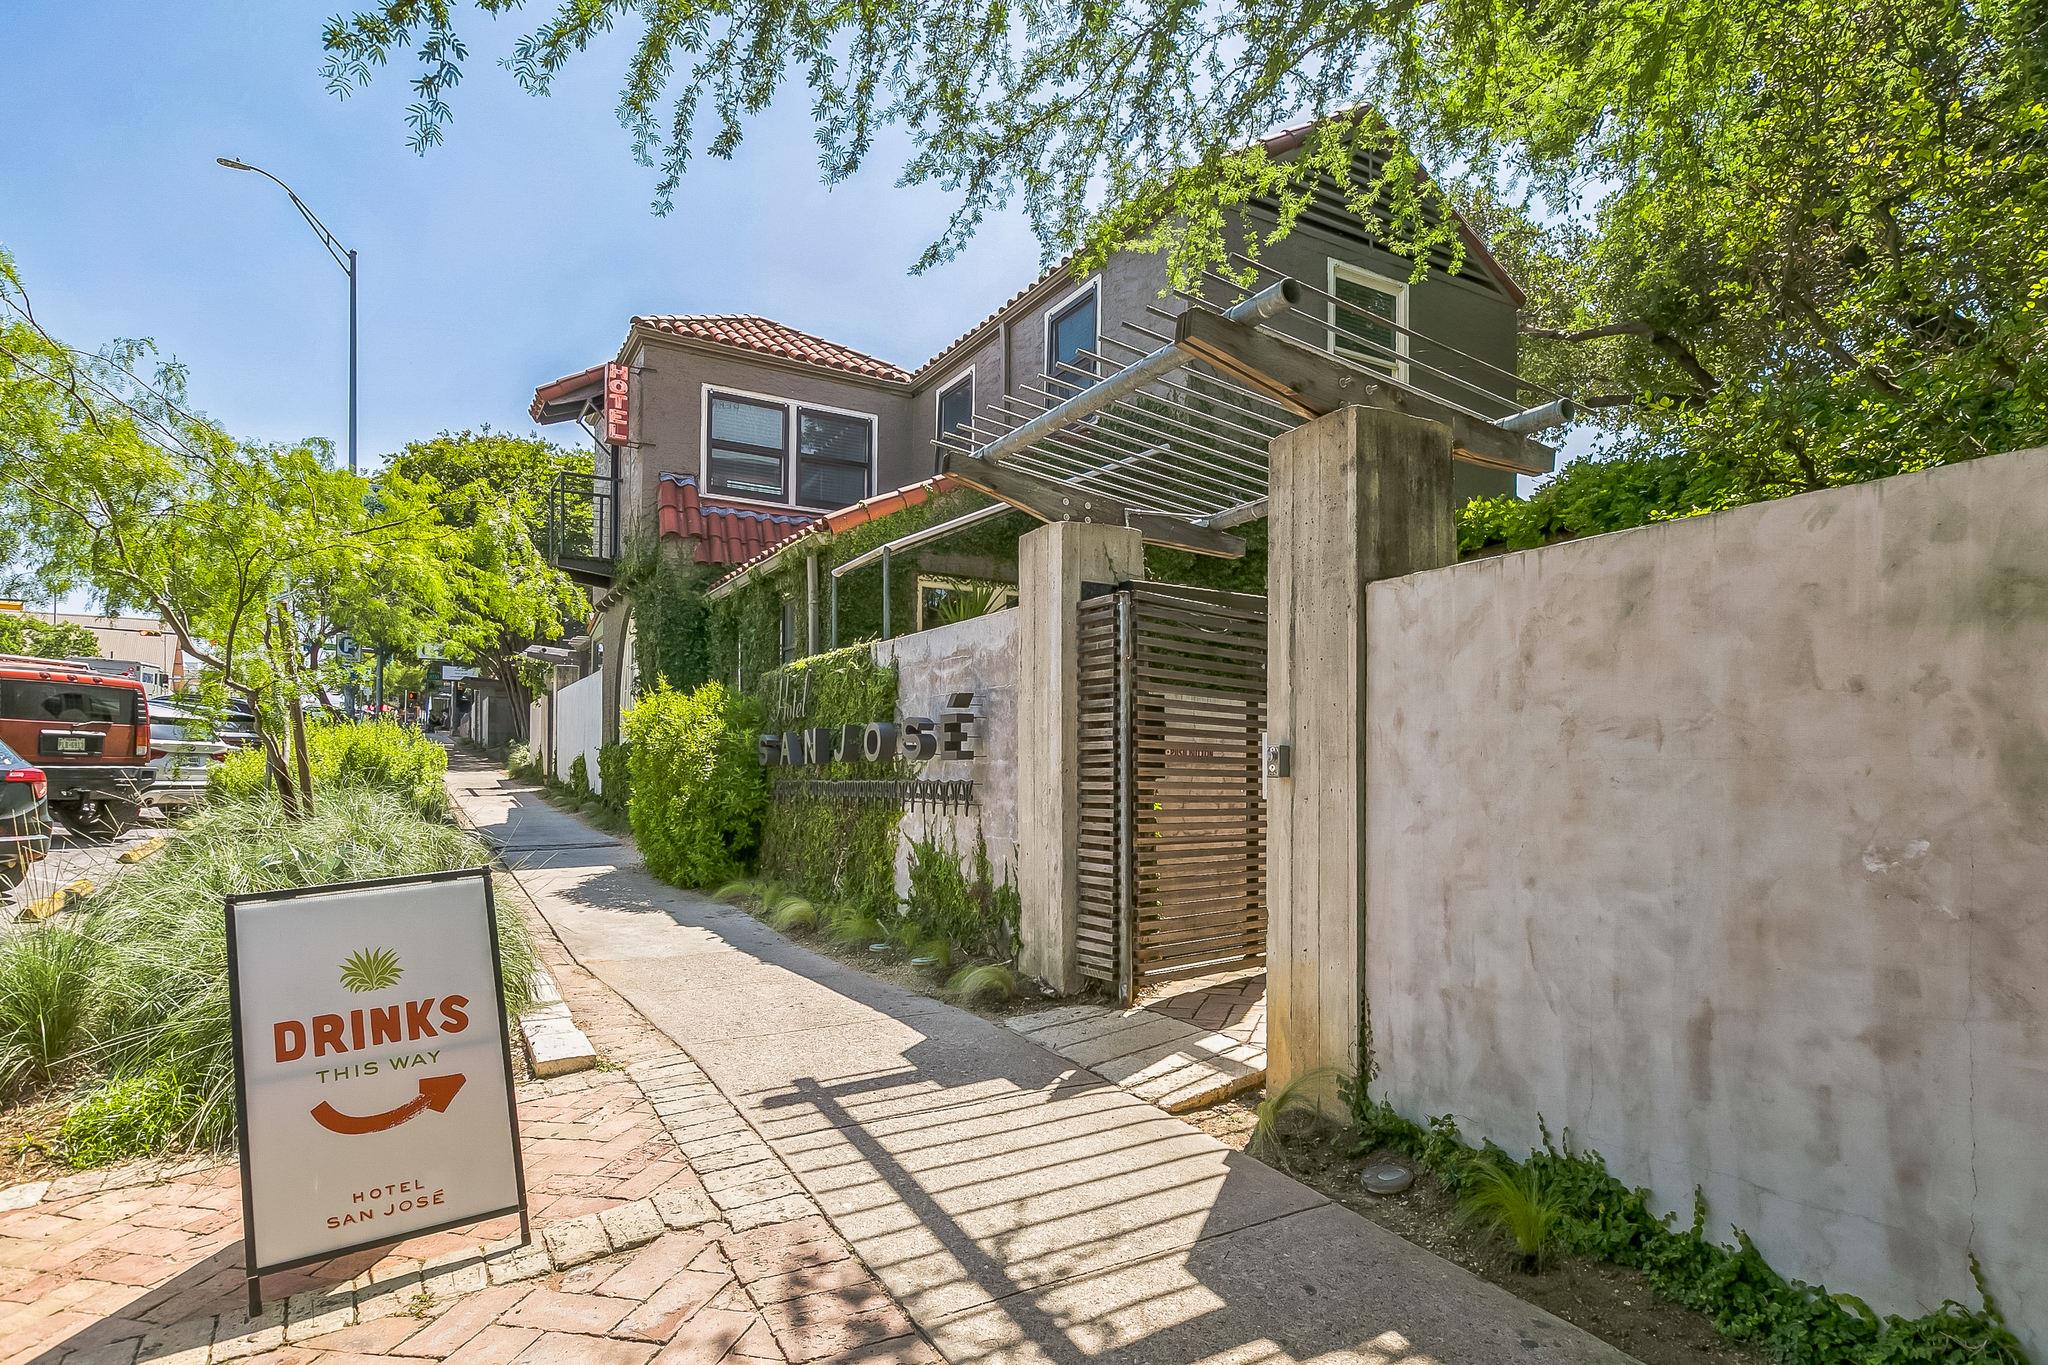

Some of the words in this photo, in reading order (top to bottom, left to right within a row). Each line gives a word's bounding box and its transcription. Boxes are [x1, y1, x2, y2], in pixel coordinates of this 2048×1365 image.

[608, 363, 629, 440] HOTEL
[758, 728, 828, 766] SAN
[833, 692, 975, 763] JOSÉ
[273, 994, 470, 1064] DRINKS
[315, 1060, 379, 1084] THIS
[389, 1050, 441, 1071] WAY
[326, 1208, 375, 1231] SAN
[383, 1188, 446, 1217] JOSÉ
[352, 1179, 425, 1204] HOTEL
